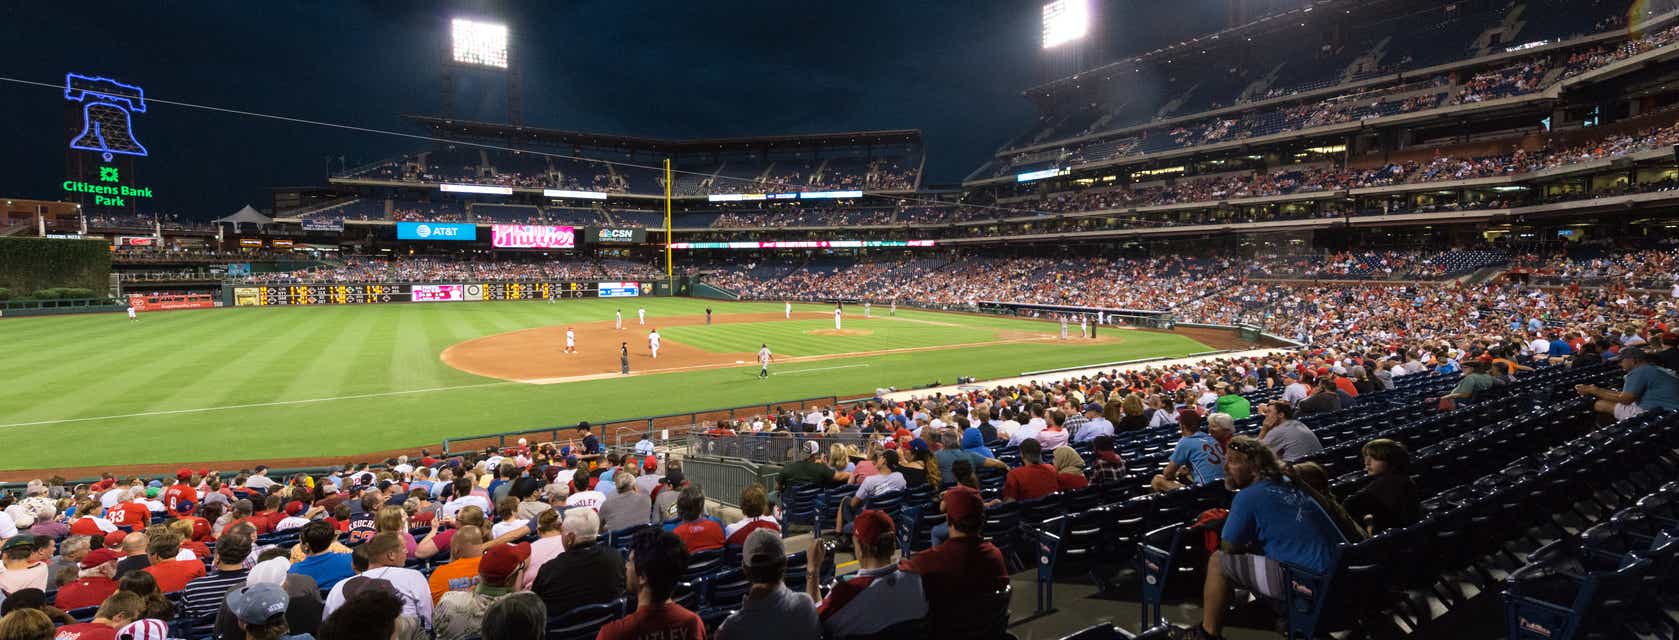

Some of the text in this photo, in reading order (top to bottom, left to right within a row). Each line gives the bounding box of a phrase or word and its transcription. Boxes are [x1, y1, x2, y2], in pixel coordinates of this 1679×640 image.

[63, 181, 152, 198] Citizens Bank
[95, 195, 124, 206] Park
[433, 227, 458, 236] AT&T
[611, 229, 632, 238] CSN
[108, 510, 125, 523] 33
